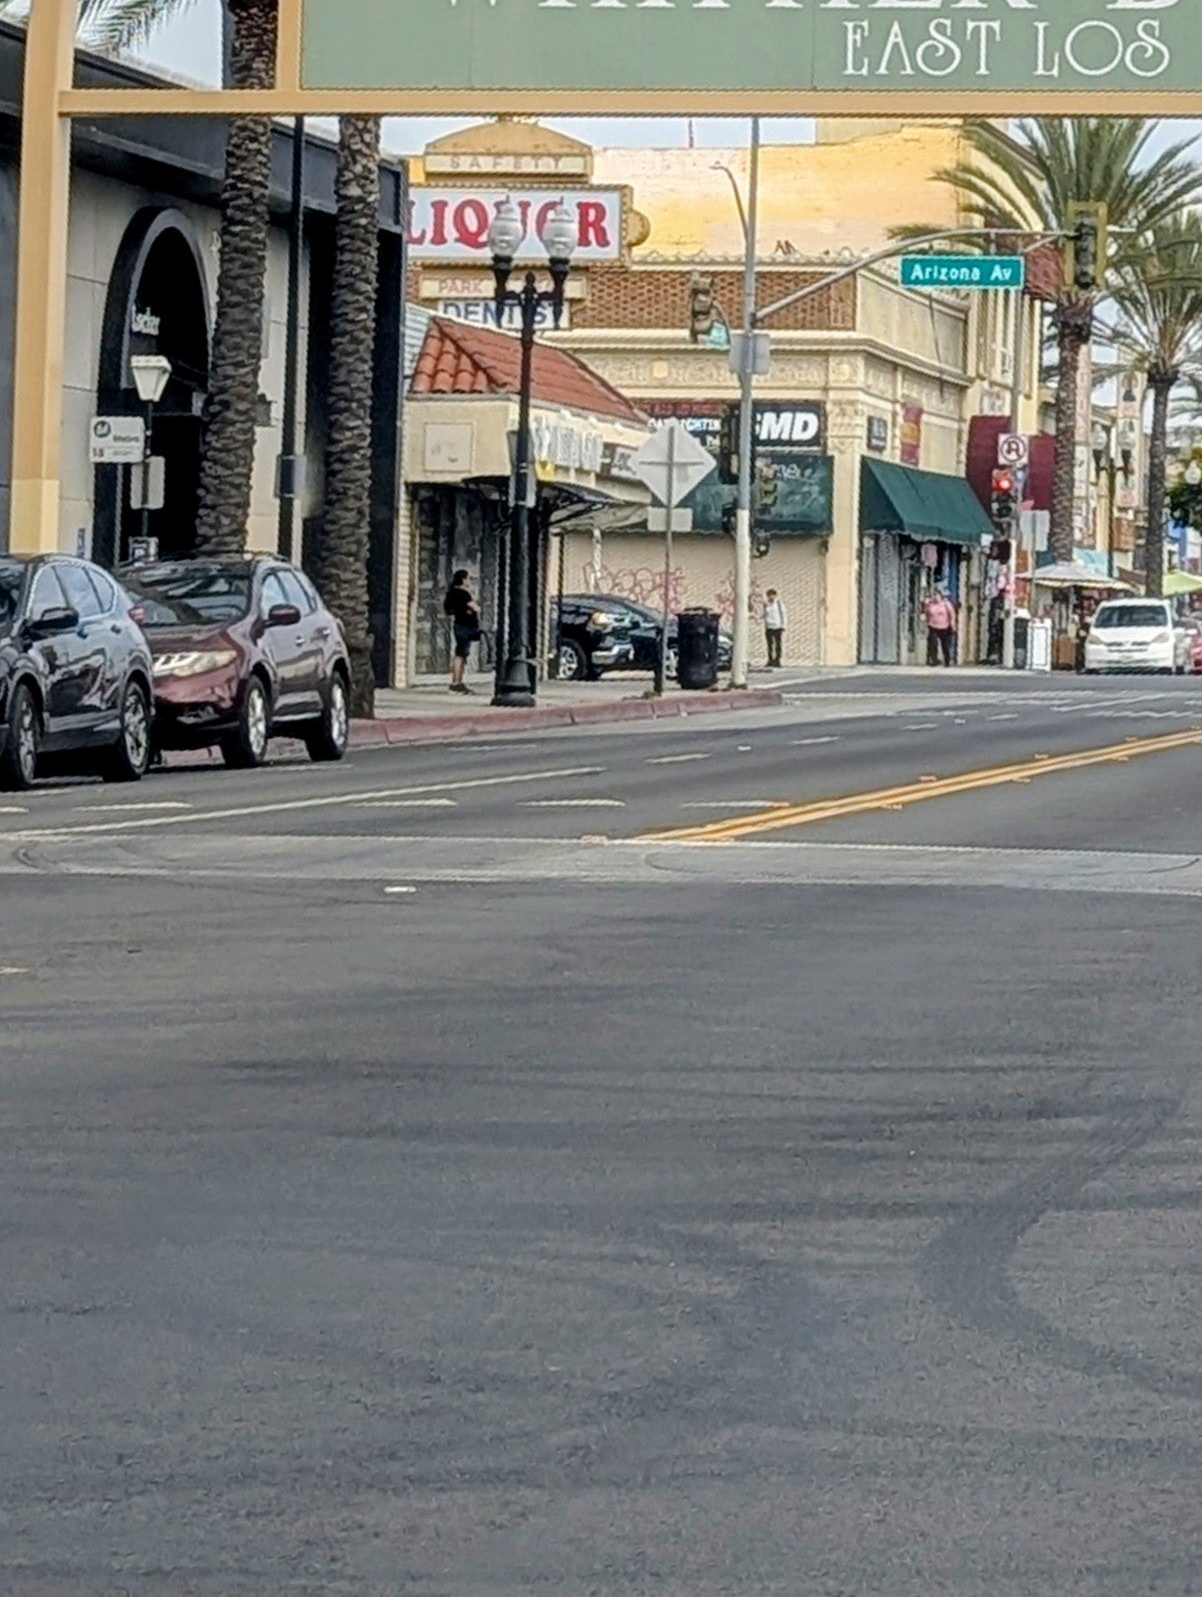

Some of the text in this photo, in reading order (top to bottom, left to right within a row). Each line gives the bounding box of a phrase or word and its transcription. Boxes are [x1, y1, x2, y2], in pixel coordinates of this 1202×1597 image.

[842, 19, 1002, 77] EAST
[1033, 19, 1171, 77] LOS
[450, 155, 560, 170] SAFETY
[910, 263, 1012, 281] Arizona Av
[755, 410, 819, 441] MD
